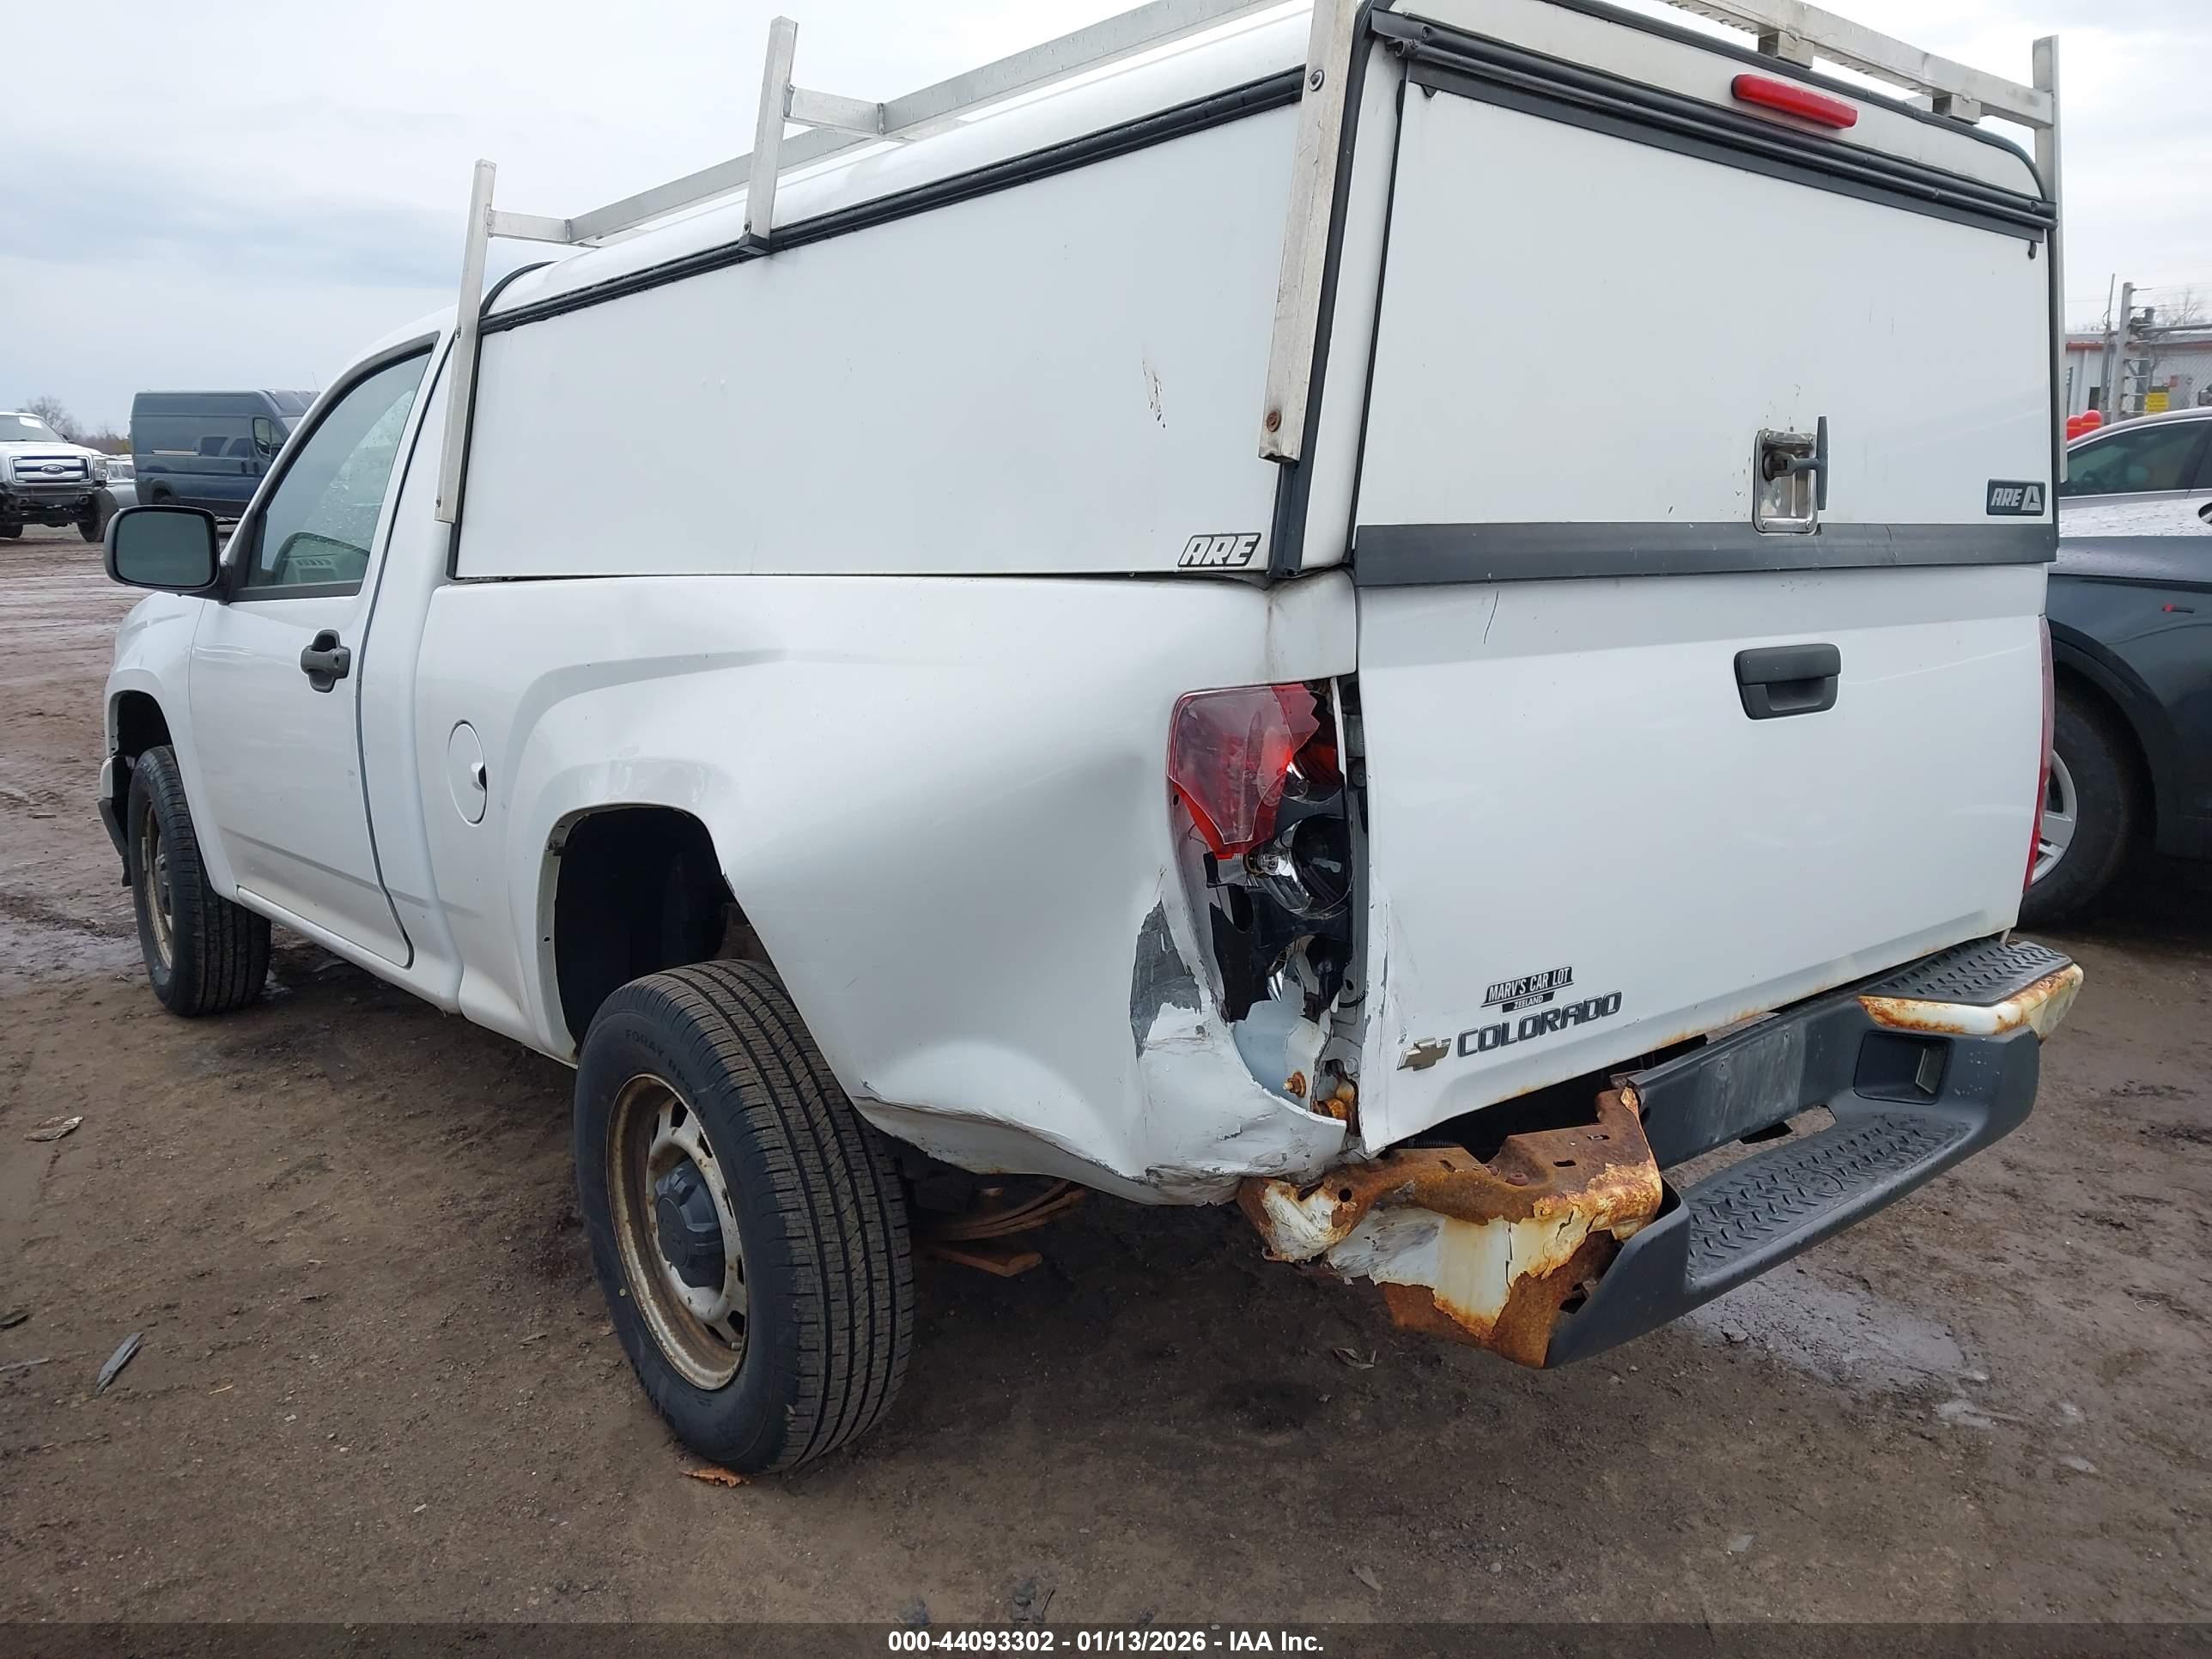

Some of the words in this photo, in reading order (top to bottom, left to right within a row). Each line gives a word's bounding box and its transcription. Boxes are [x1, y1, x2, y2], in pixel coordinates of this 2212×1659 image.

[1991, 488, 2022, 507] ARE
[1177, 532, 1261, 568] ARE
[1488, 979, 1527, 1002] MARV'S
[1529, 973, 1549, 992] CAR
[1553, 968, 1570, 986] LOT
[1513, 995, 1544, 1010] ZEELAND
[1457, 991, 1622, 1057] COLORADO
